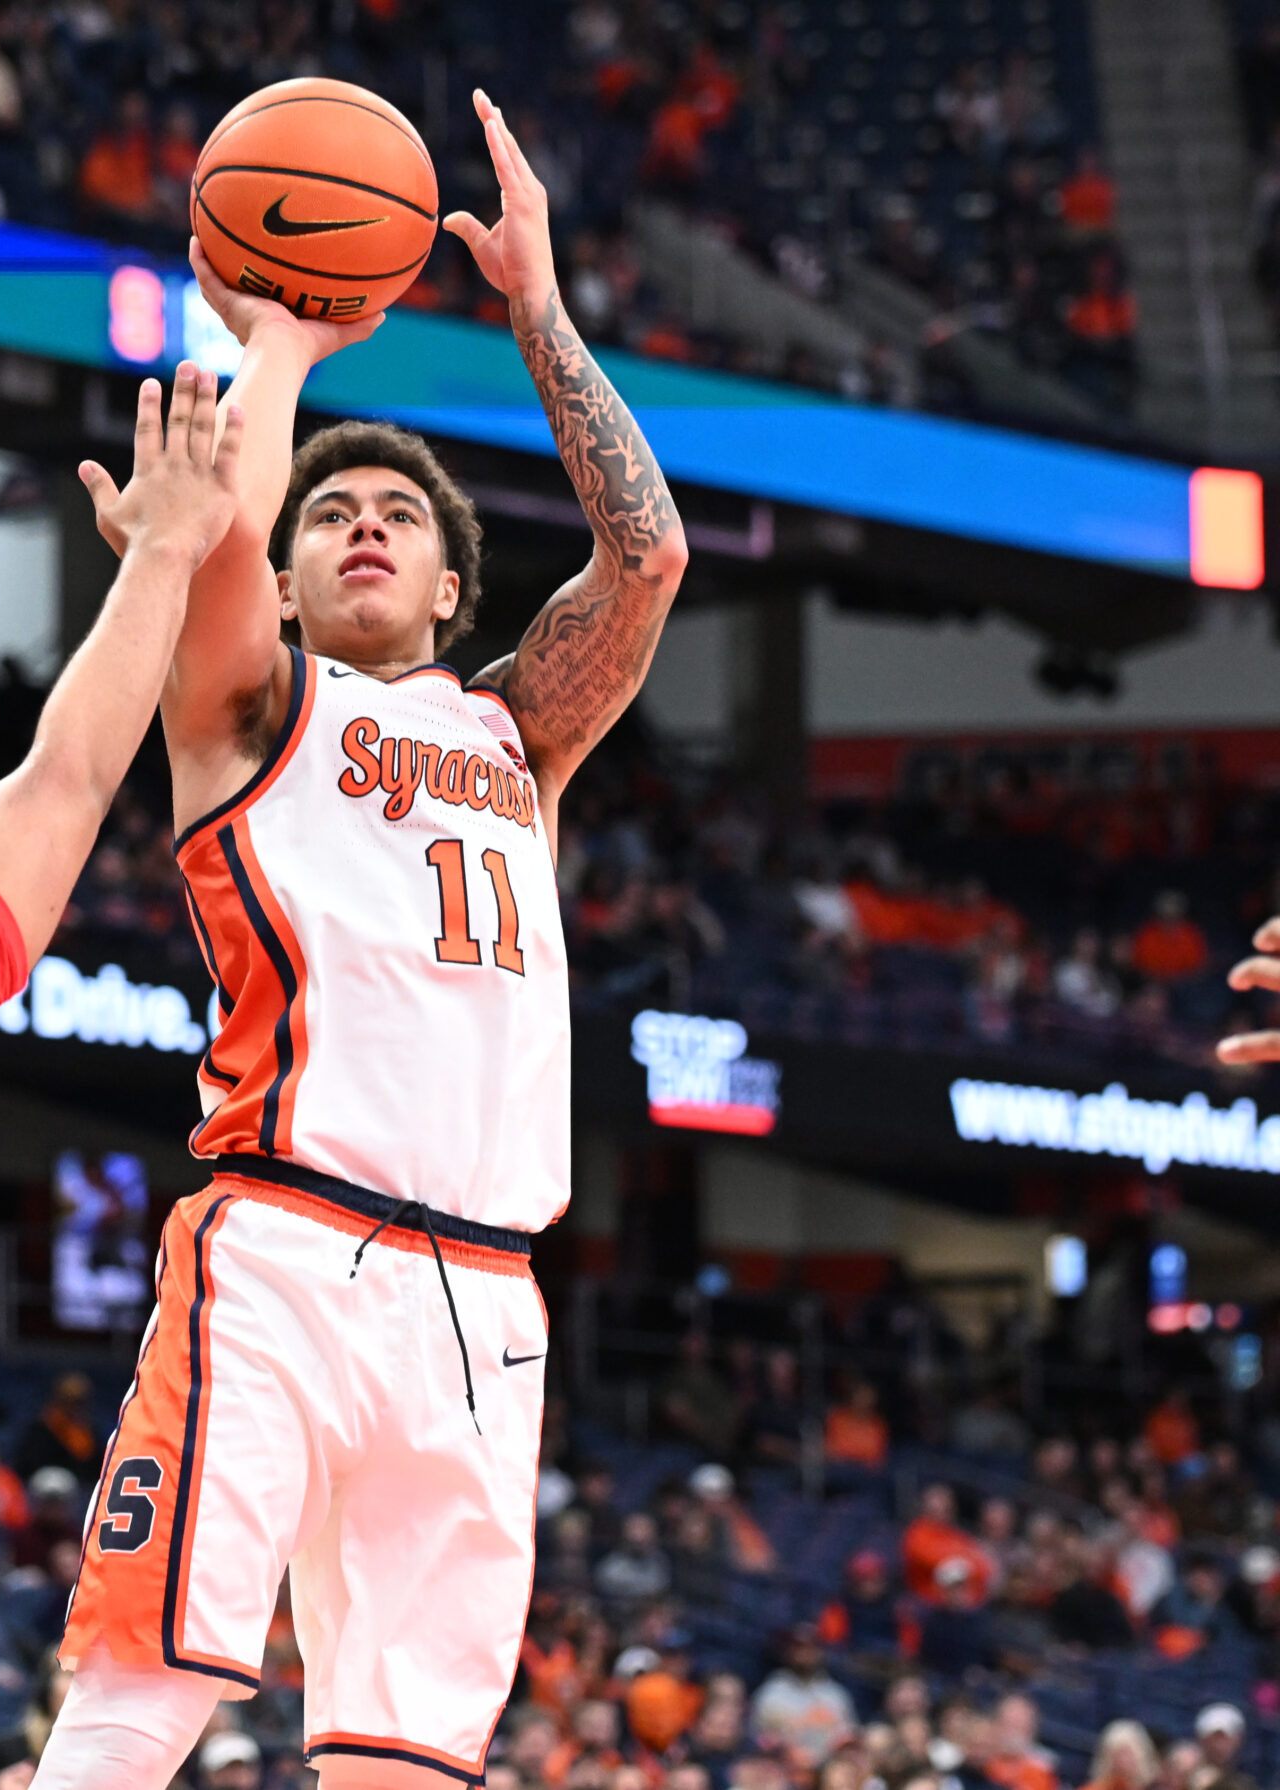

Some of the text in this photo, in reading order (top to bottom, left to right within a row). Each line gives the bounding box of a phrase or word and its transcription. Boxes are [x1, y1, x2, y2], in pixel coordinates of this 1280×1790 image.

[238, 263, 369, 318] ELITE
[338, 717, 537, 838] Syracuse
[425, 839, 525, 977] 11
[30, 955, 206, 1054] Drive.
[97, 1455, 164, 1554] S
